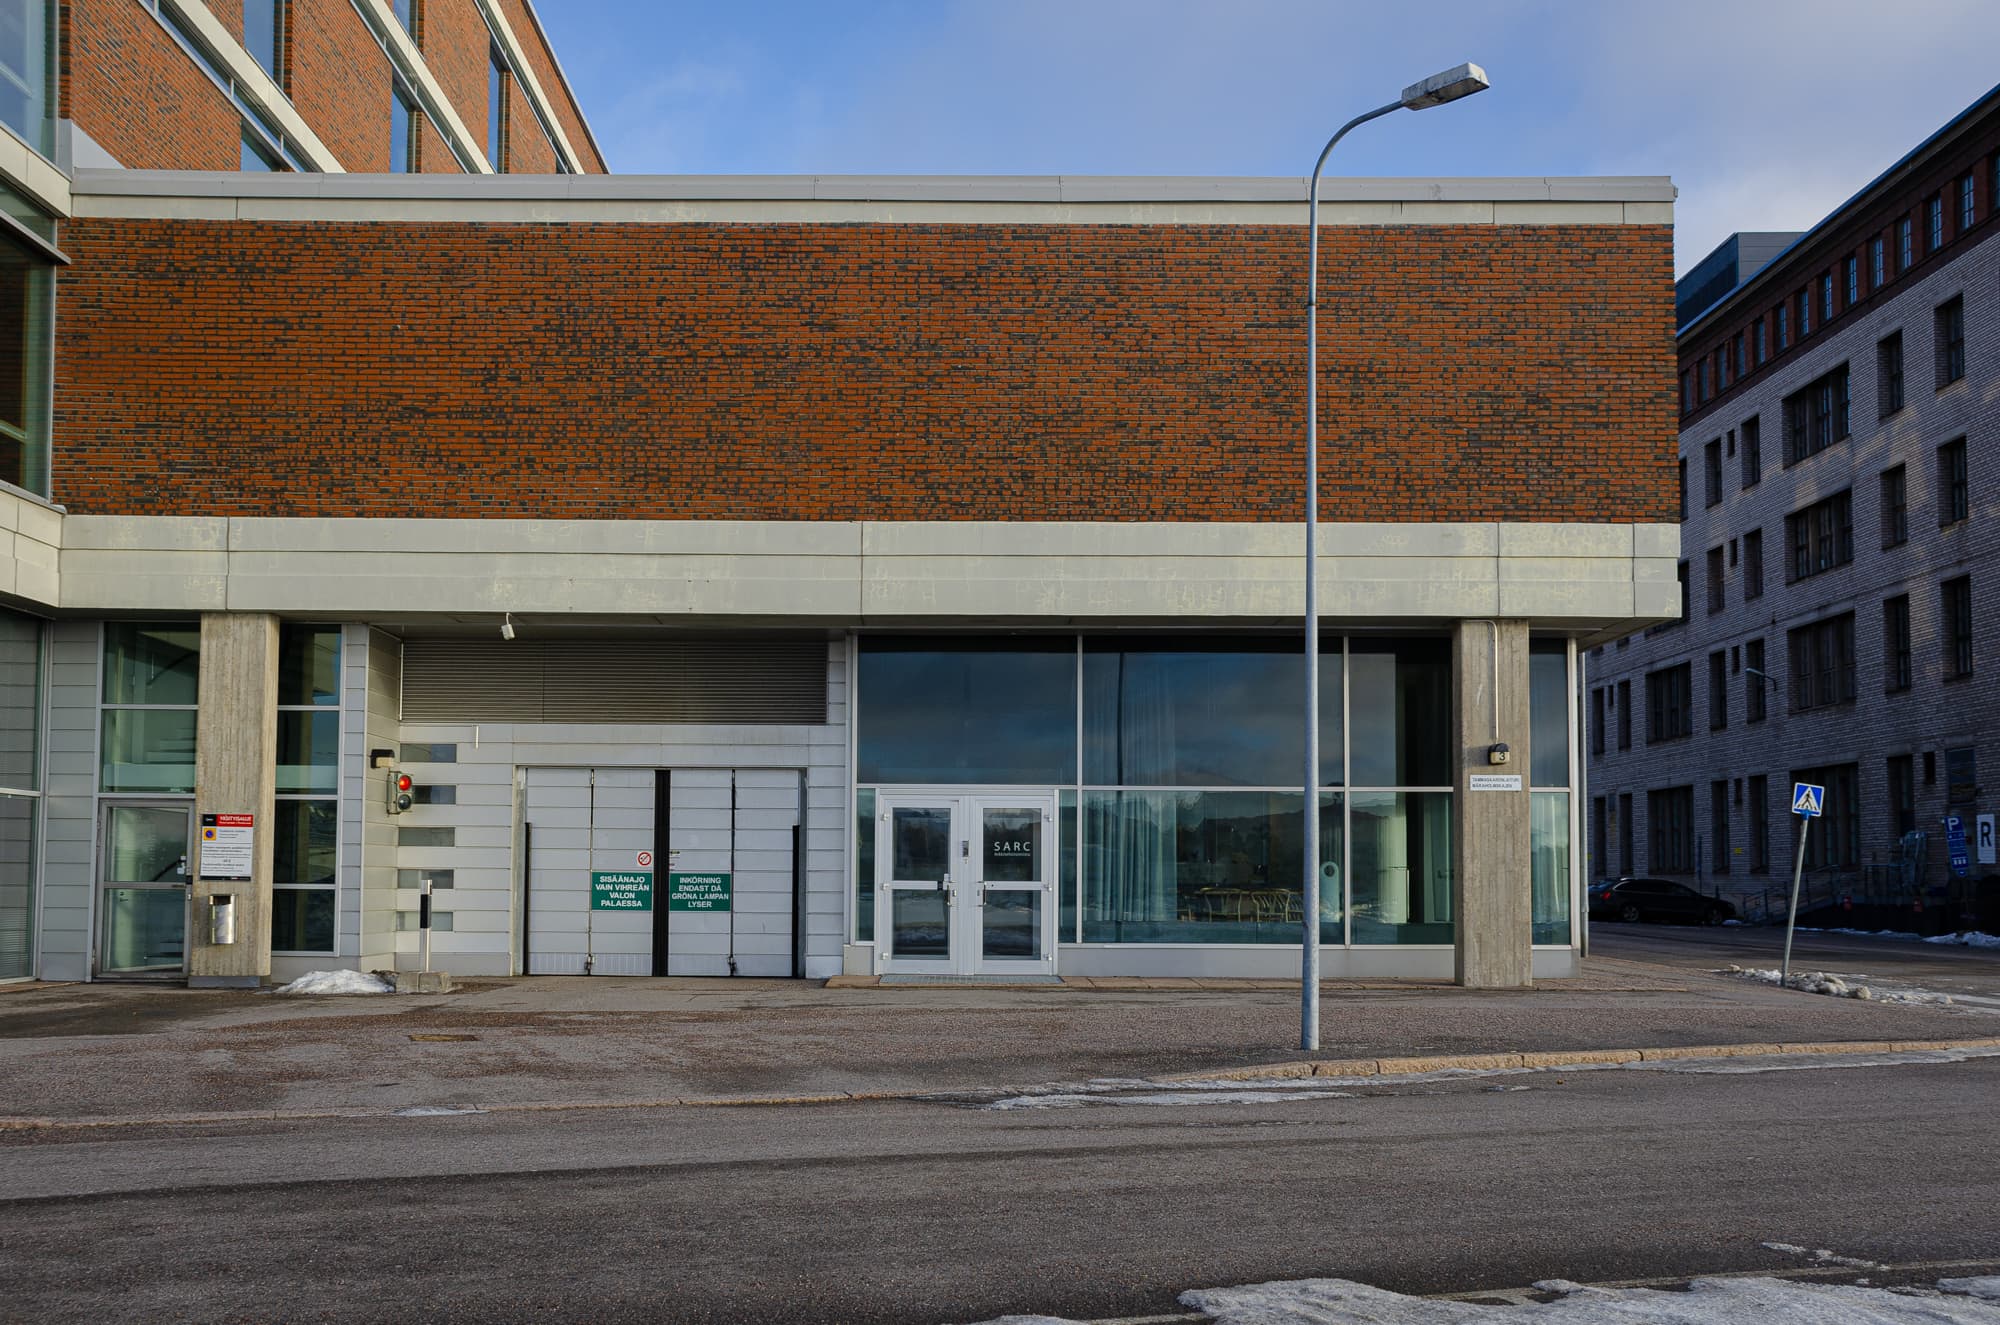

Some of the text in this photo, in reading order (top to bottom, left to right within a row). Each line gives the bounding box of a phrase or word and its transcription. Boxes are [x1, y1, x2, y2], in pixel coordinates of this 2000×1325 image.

[1499, 752, 1505, 761] 3
[1947, 817, 1959, 831] P
[1980, 822, 1992, 848] R
[994, 841, 1031, 851] SARC
[600, 875, 645, 883] SISÄÄNAJO
[679, 876, 722, 884] INKÖRNING
[615, 883, 650, 891] VIHREÄN
[711, 884, 722, 892] DÅ
[671, 892, 698, 900] GRÖNA
